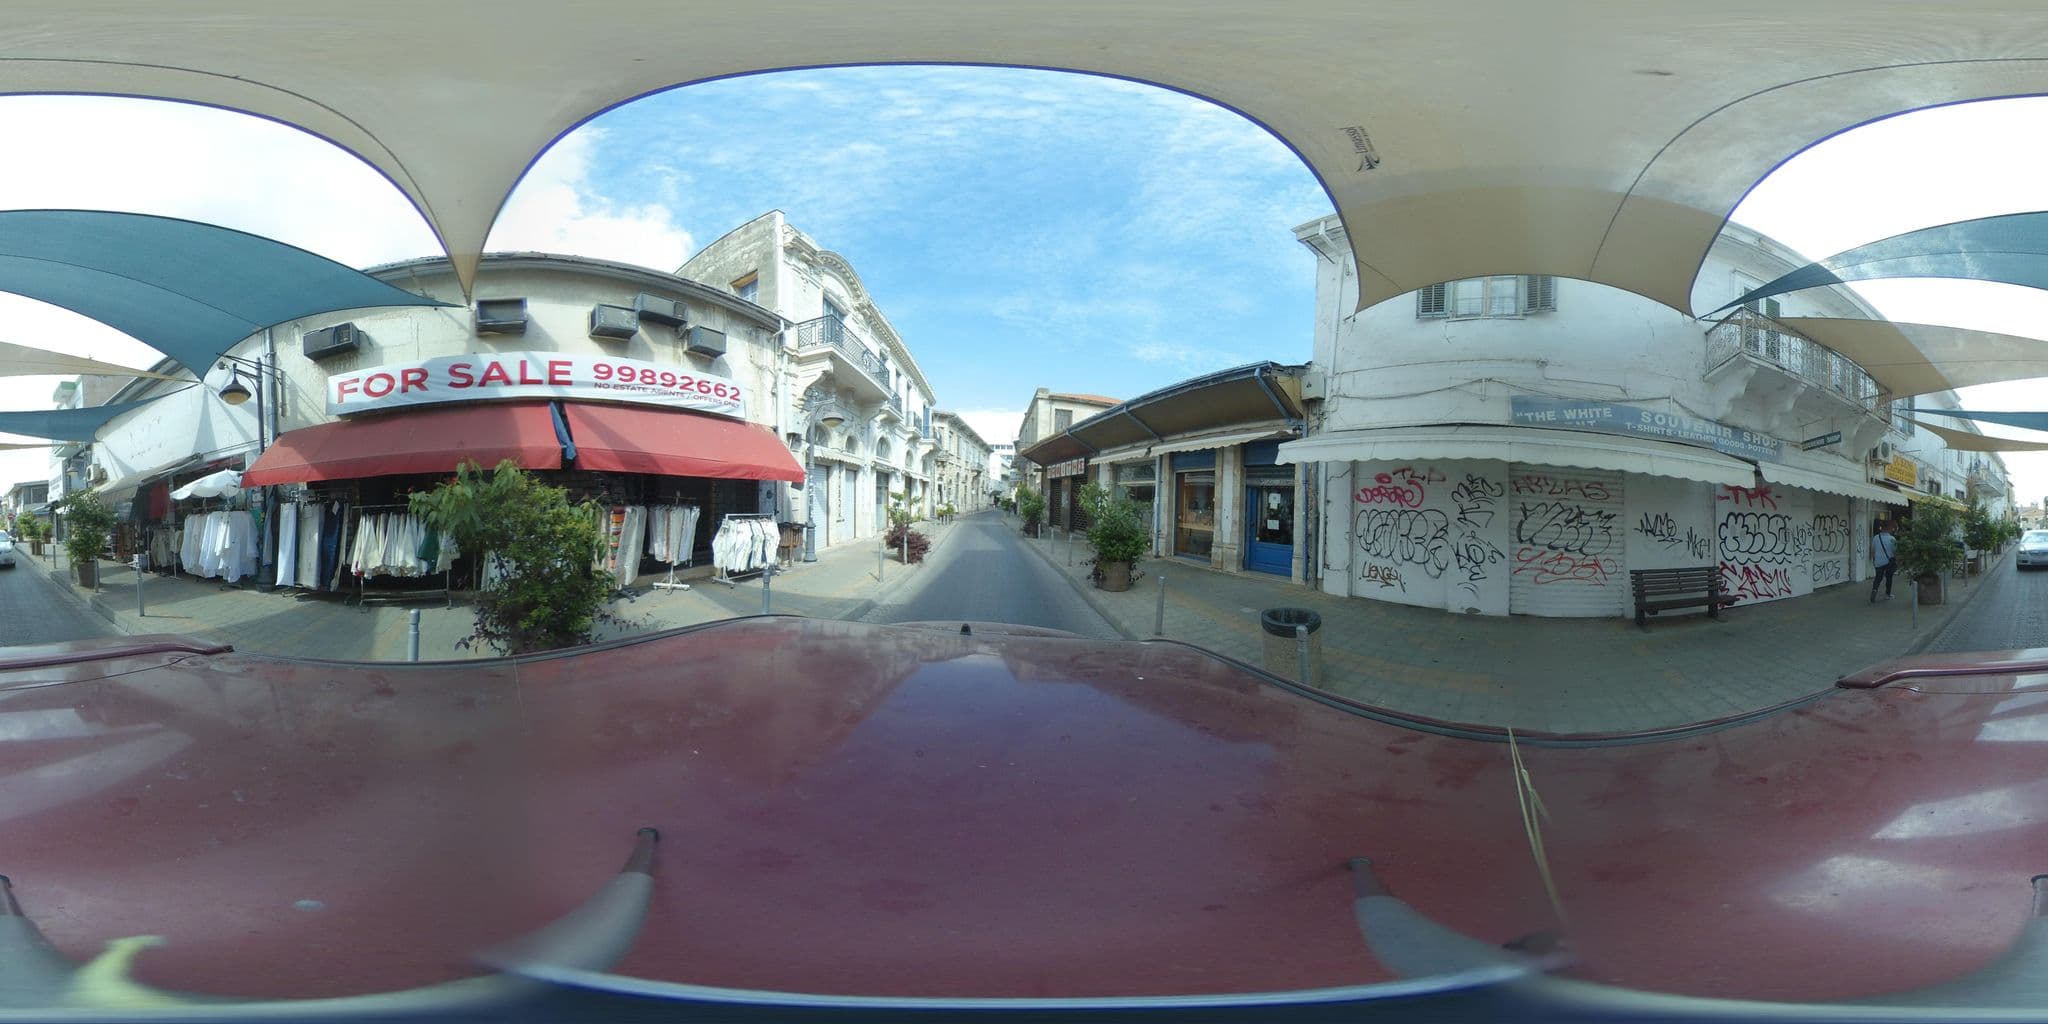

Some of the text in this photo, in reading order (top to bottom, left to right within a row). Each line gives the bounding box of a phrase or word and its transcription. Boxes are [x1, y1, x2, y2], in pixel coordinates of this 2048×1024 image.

[336, 360, 741, 403] FOR SALE 99892662
[613, 384, 648, 393] ESTATE
[693, 395, 723, 404] OFFERS
[1563, 407, 1613, 420] WHITE
[1640, 411, 1779, 449] SOUVENIR SHOP
